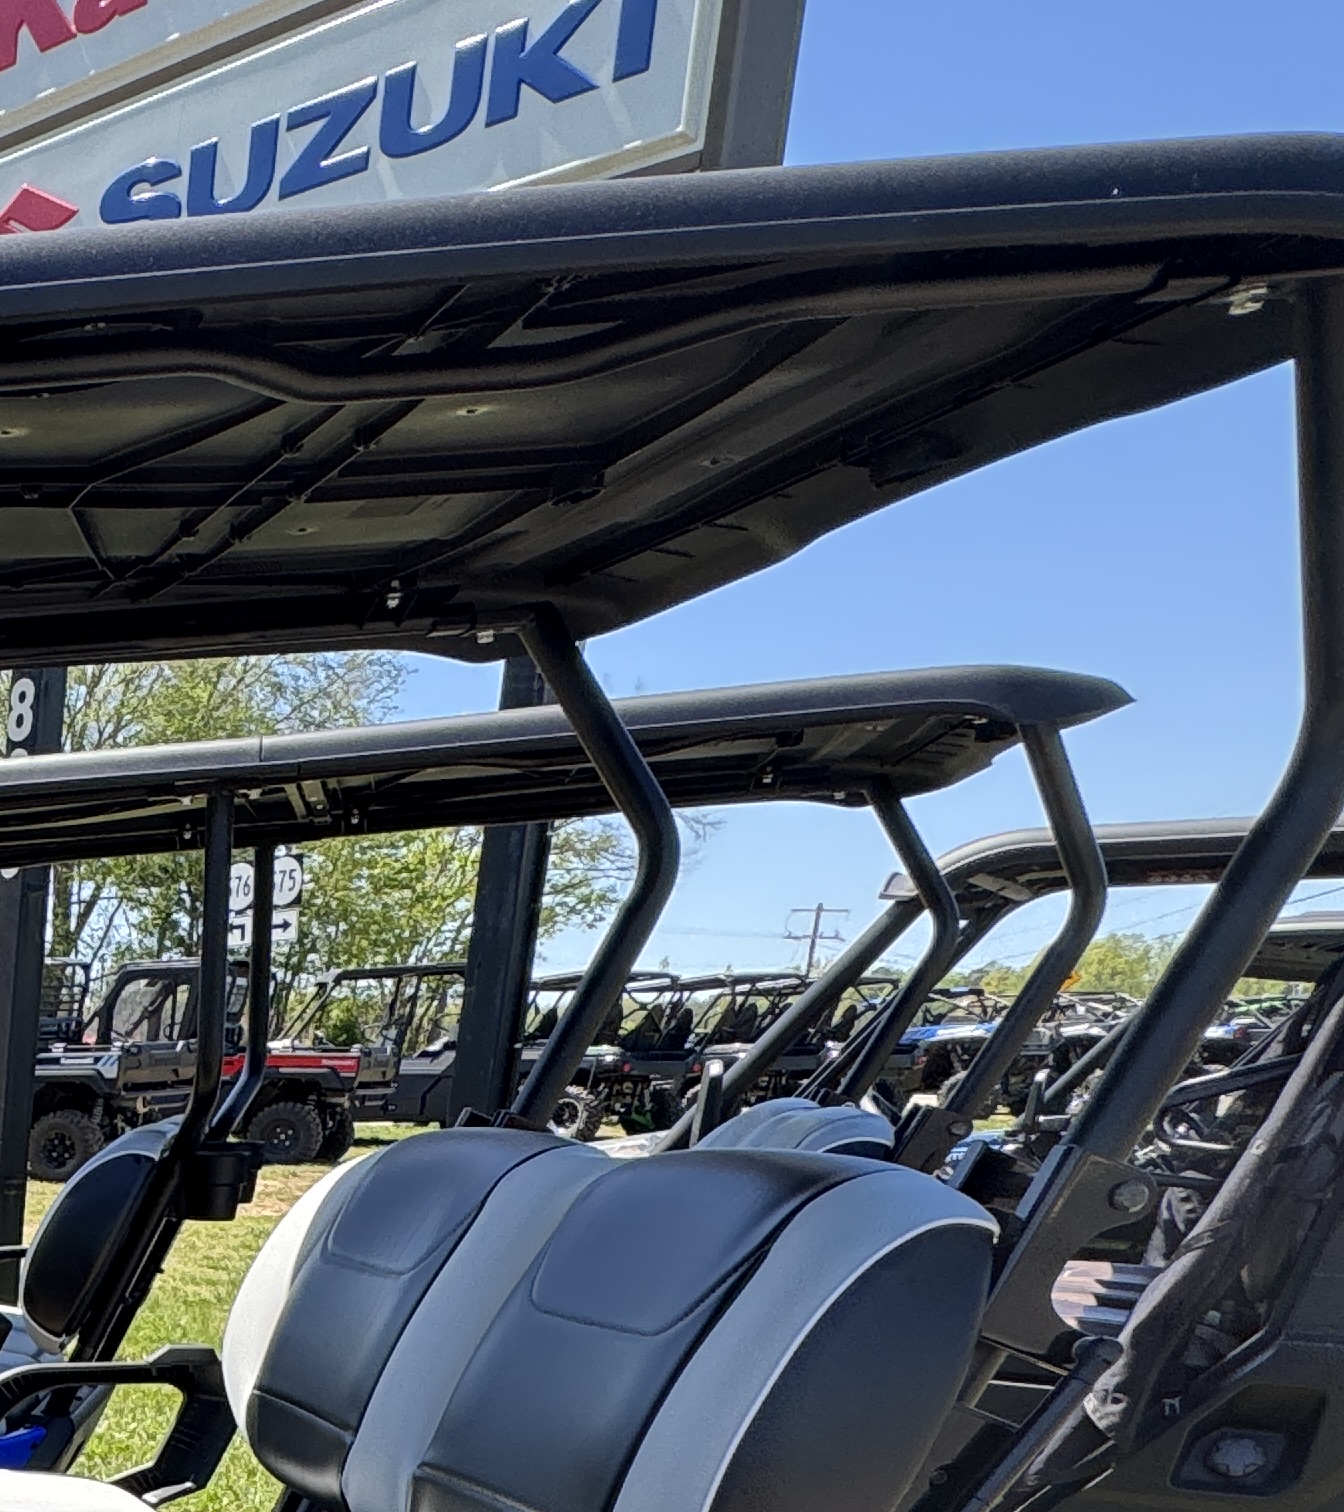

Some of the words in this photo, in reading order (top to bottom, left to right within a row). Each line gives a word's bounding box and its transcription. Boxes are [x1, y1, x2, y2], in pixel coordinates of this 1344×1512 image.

[100, 0, 657, 223] SUZUKI
[231, 874, 251, 898] 76
[273, 868, 297, 893] 75
